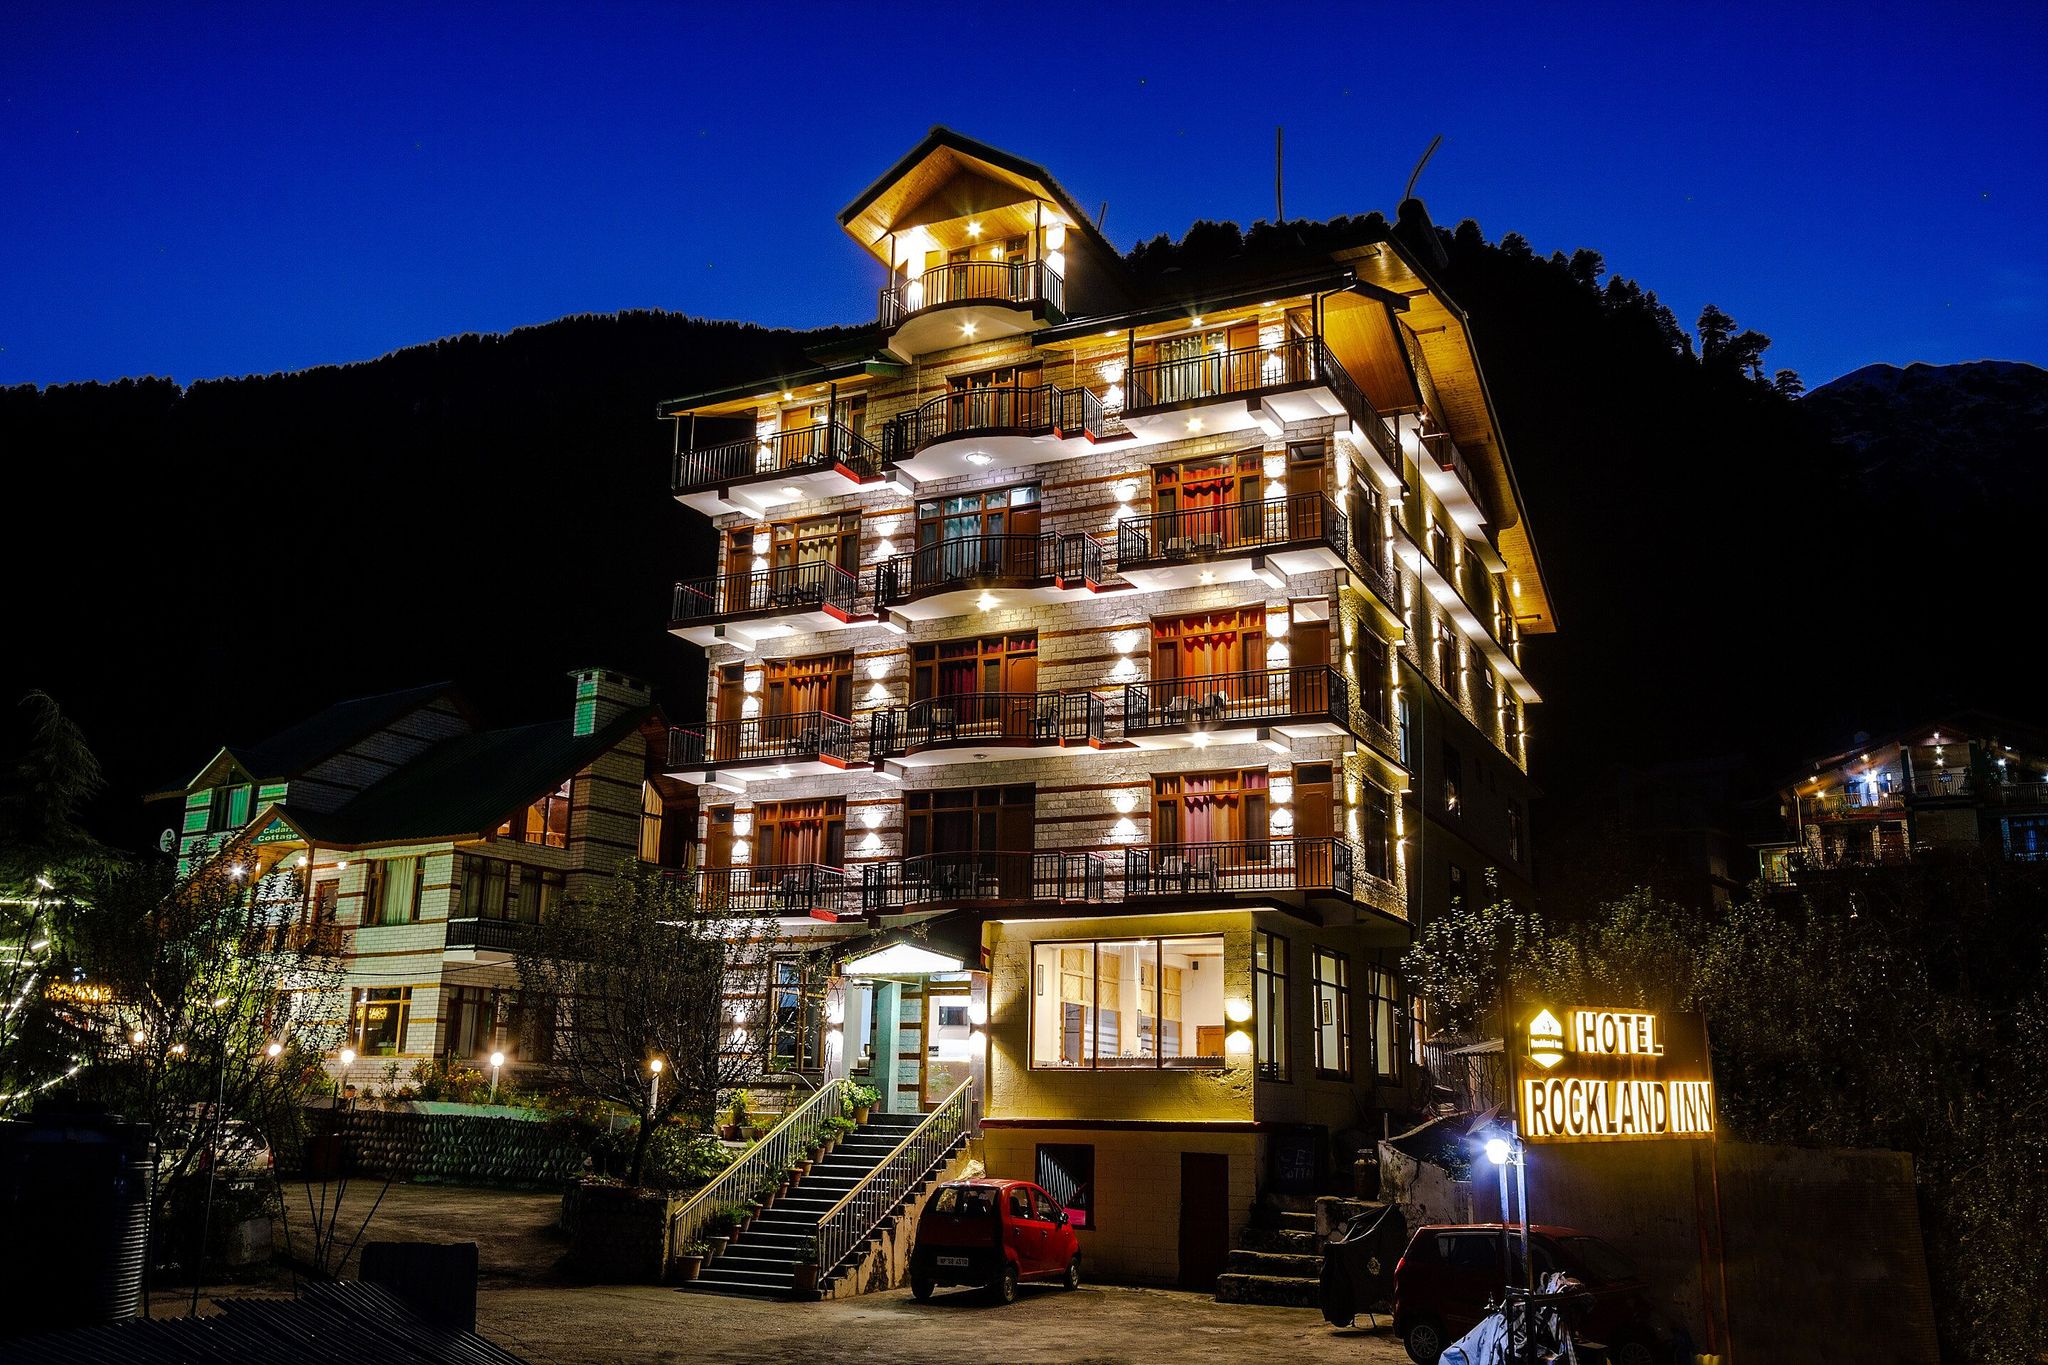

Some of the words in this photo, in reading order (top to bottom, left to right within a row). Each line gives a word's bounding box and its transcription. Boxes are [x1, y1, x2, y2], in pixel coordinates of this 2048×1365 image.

[257, 833, 299, 842] Cottage
[1577, 1011, 1664, 1056] HOTEL
[1526, 1078, 1667, 1136] ROCKLAND
[1670, 1081, 1713, 1132] INN
